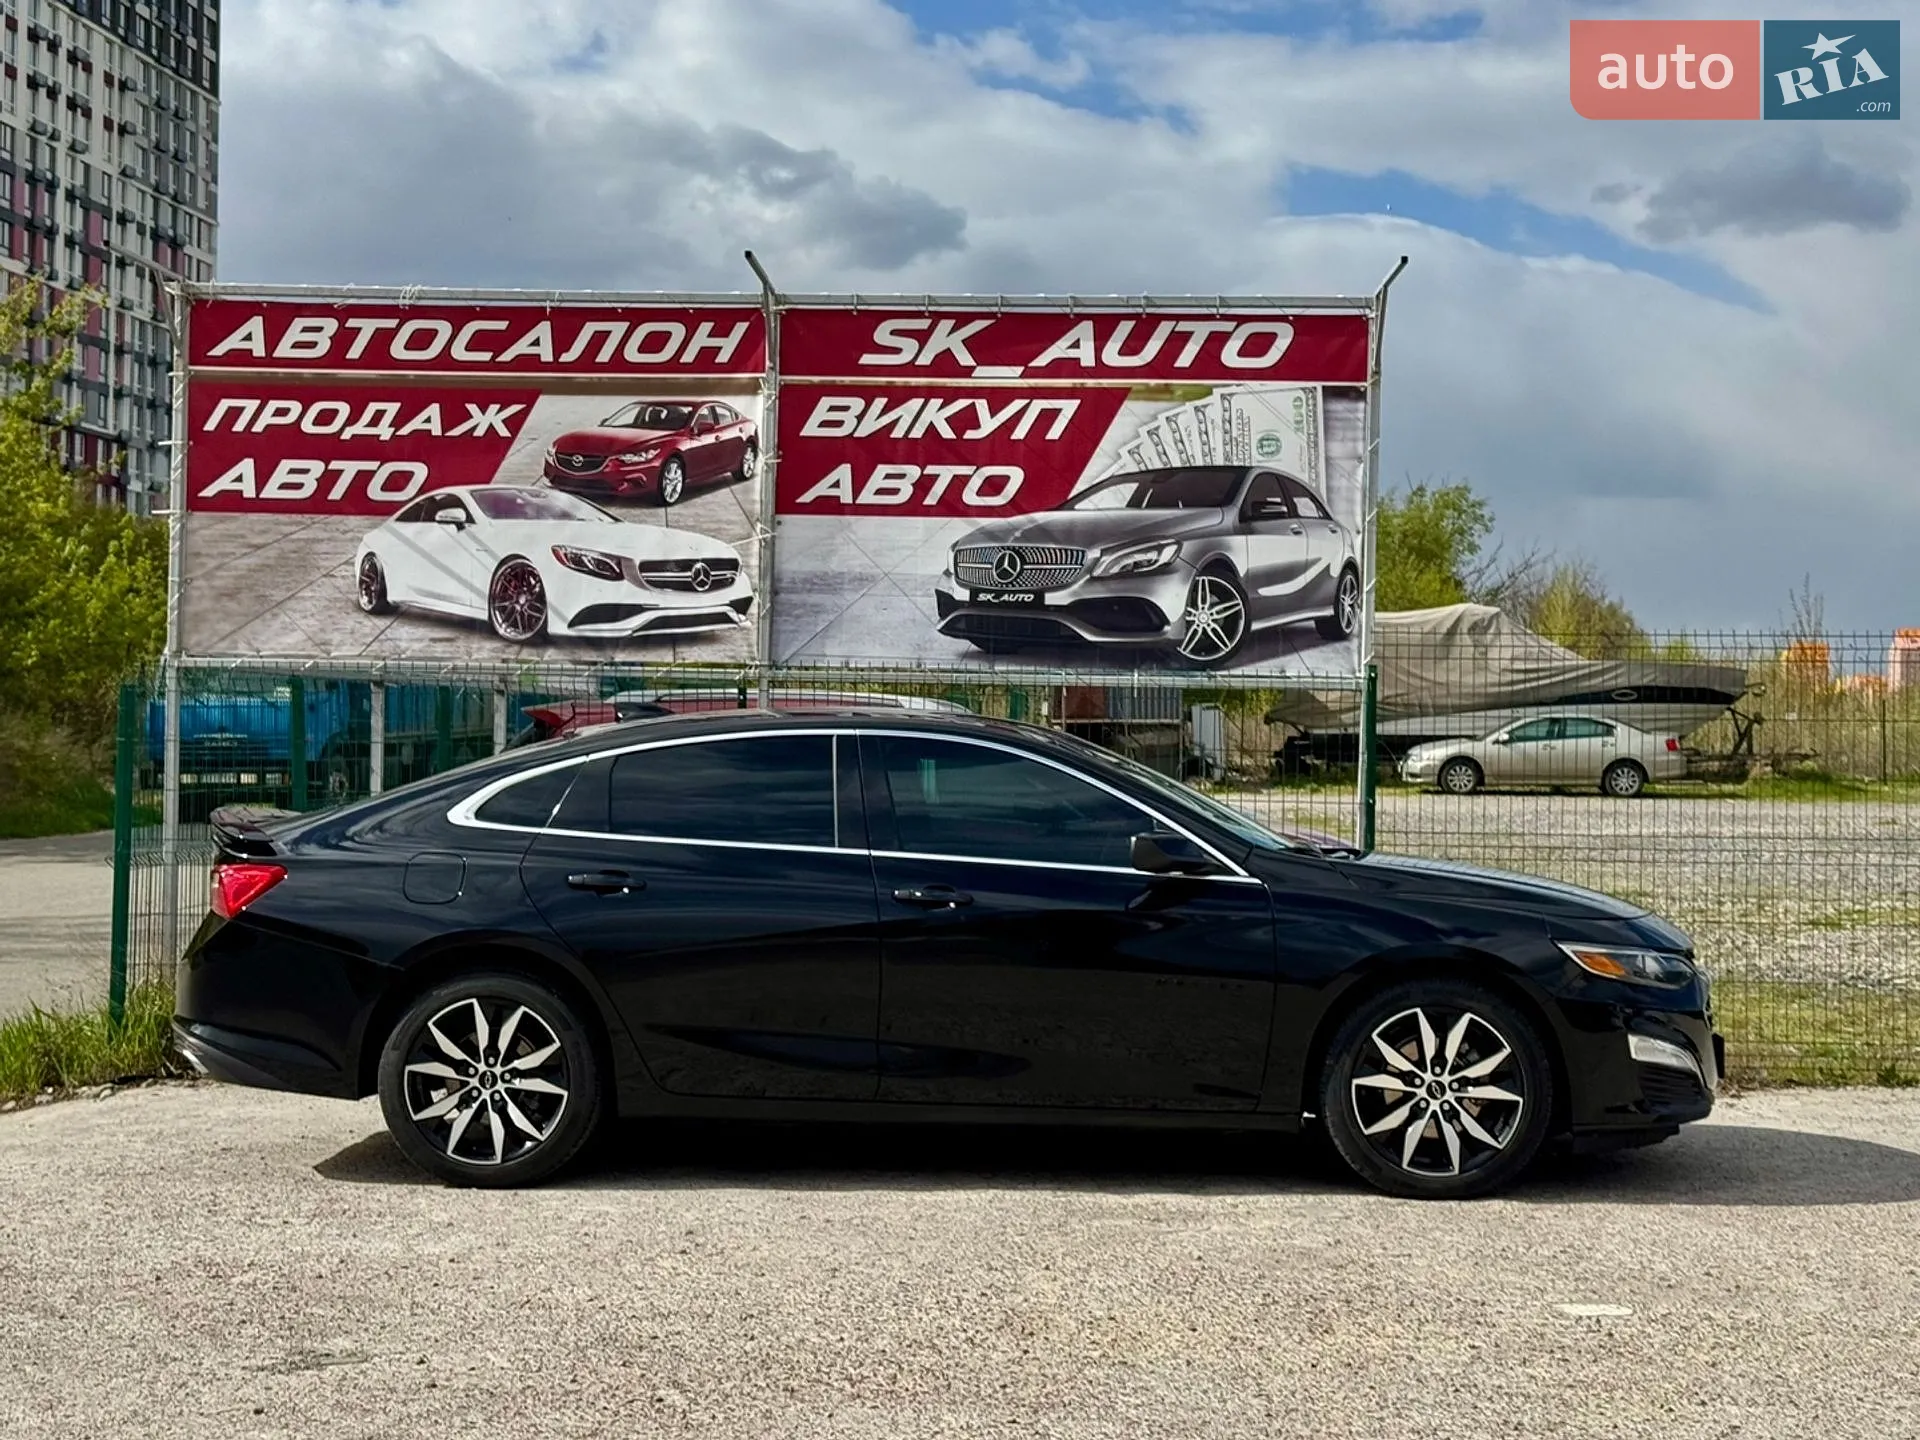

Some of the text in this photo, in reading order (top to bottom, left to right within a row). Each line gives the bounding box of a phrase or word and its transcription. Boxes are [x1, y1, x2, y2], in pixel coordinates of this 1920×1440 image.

[206, 315, 749, 364] АВТОСАЛОН
[857, 318, 1296, 378] SK_AUTO
[203, 398, 527, 440] ПРОДАЖ
[799, 396, 1081, 440] ВИКУП
[198, 458, 430, 501] АВТО
[795, 463, 1025, 506] АВТО
[976, 592, 1035, 603] SK_AUTO
